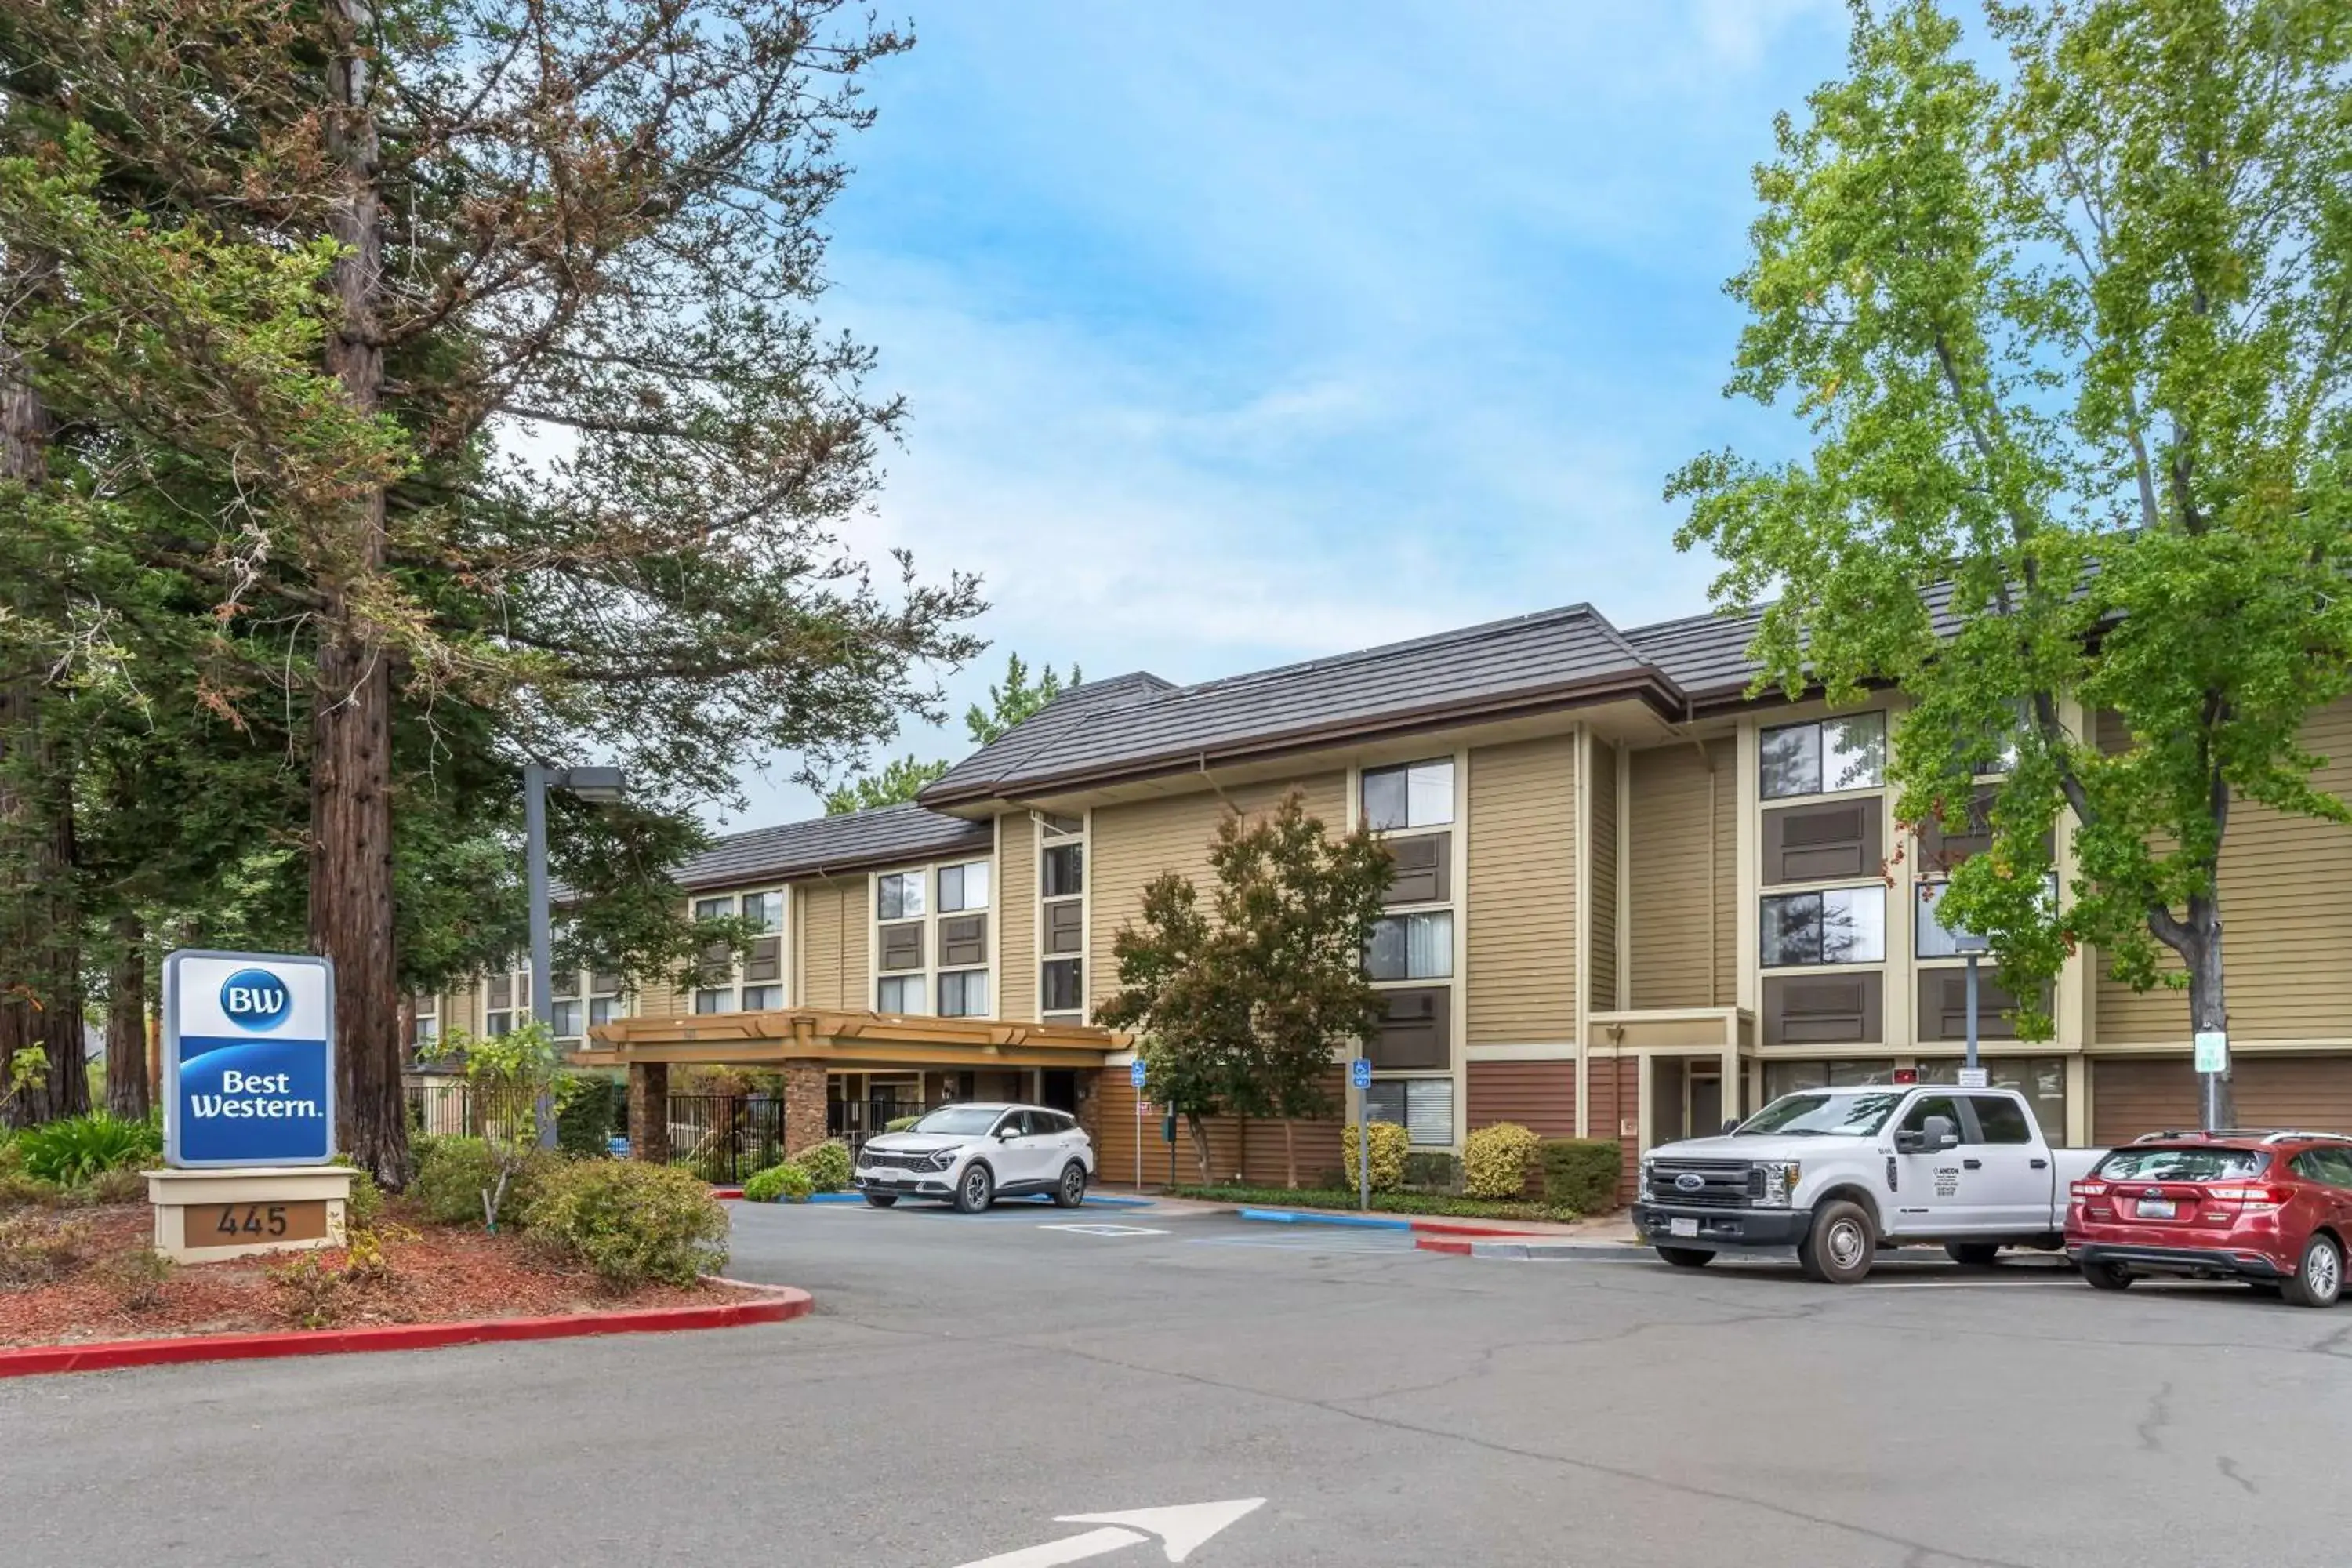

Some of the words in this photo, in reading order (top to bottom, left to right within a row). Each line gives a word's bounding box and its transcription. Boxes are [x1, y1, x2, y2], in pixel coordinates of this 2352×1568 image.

[230, 987, 283, 1014] BW
[223, 1070, 291, 1094] Best
[217, 1204, 286, 1236] 445
